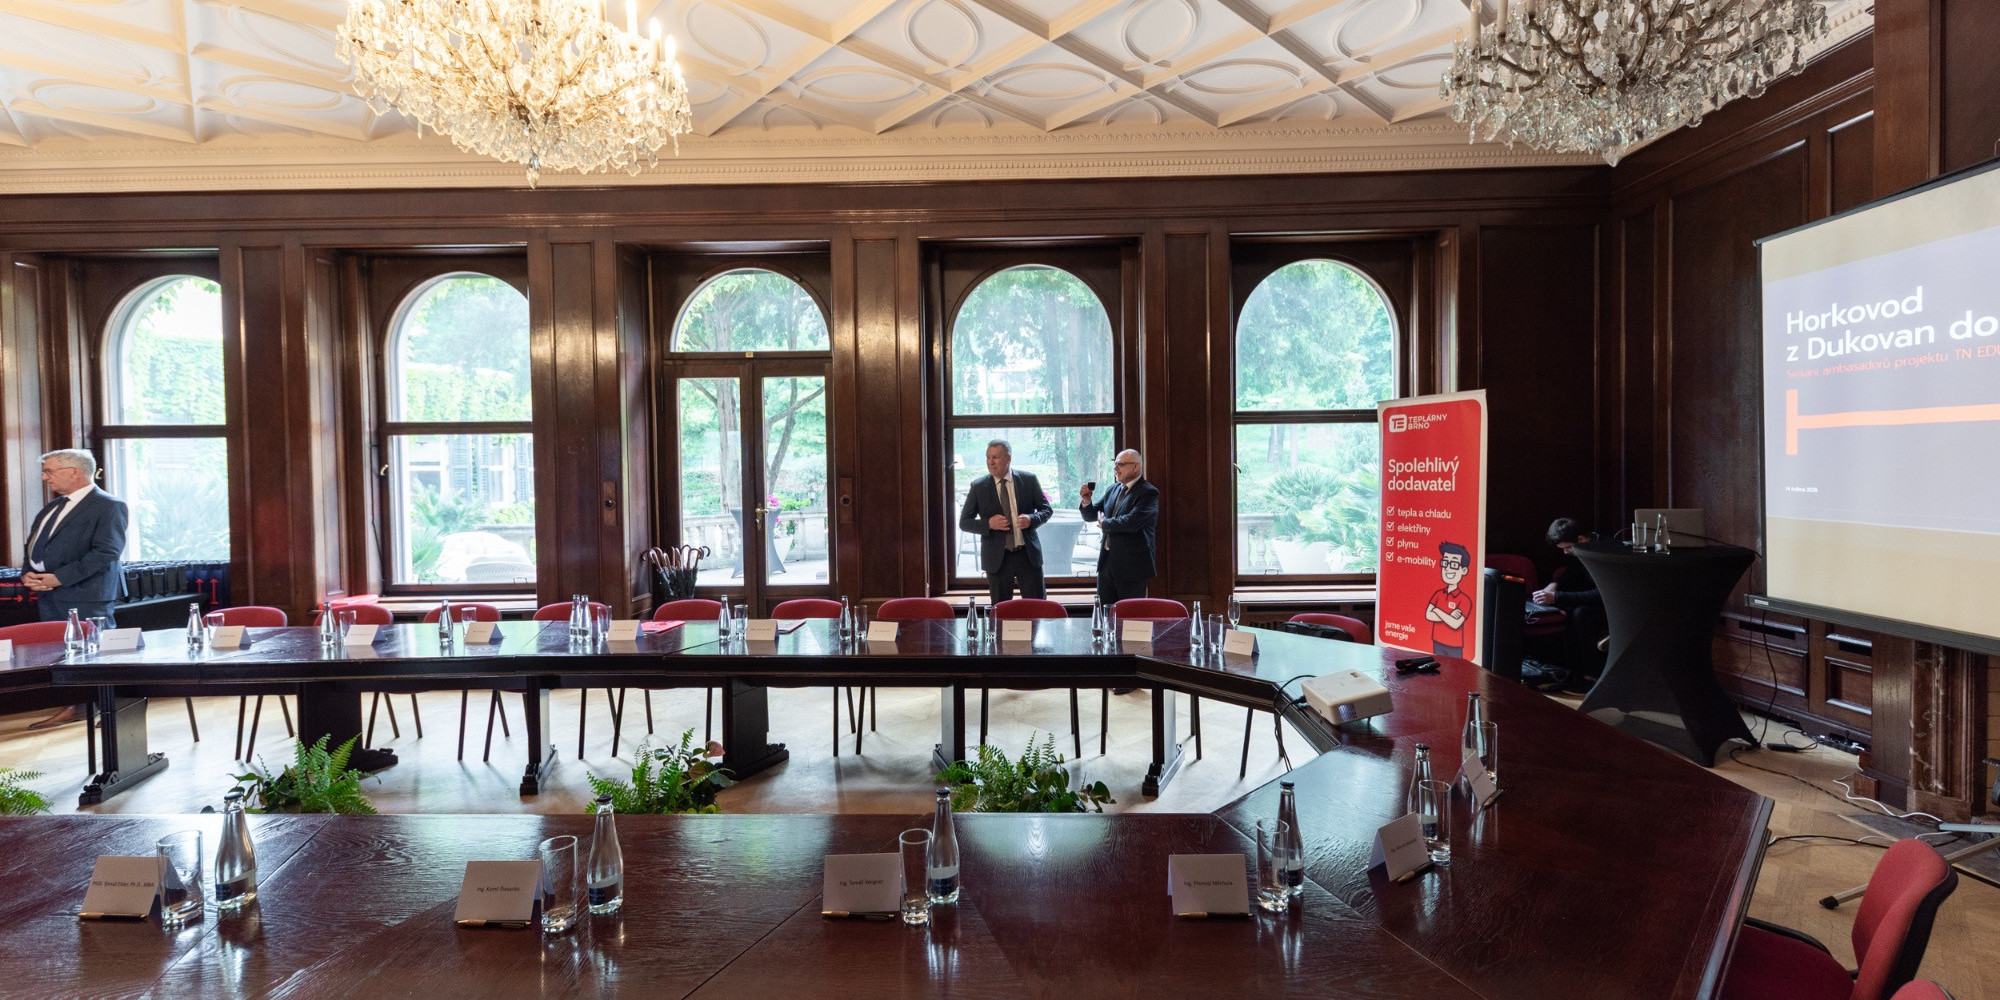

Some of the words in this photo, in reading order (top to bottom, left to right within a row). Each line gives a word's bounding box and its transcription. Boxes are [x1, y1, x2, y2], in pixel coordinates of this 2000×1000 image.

[1786, 285, 1923, 335] Horkovod
[1786, 345, 1799, 362] z
[1807, 324, 1935, 360] Dukovan
[1949, 309, 1999, 340] do
[1822, 355, 1891, 376] ambasadorů
[1894, 351, 1949, 372] projektu
[1953, 346, 1972, 360] TN
[1408, 413, 1448, 423] TEPLÁRNY
[1408, 422, 1430, 430] BRNO
[1388, 456, 1460, 477] Spolehlivý
[1387, 475, 1456, 492] dodavatel
[1397, 508, 1417, 519] tepla
[1418, 510, 1424, 518] a
[1424, 509, 1452, 519] chladu
[1397, 523, 1431, 536] elektřiny
[1397, 539, 1419, 549] plynu
[1397, 555, 1437, 569] e-mobility
[1385, 630, 1409, 641] energie
